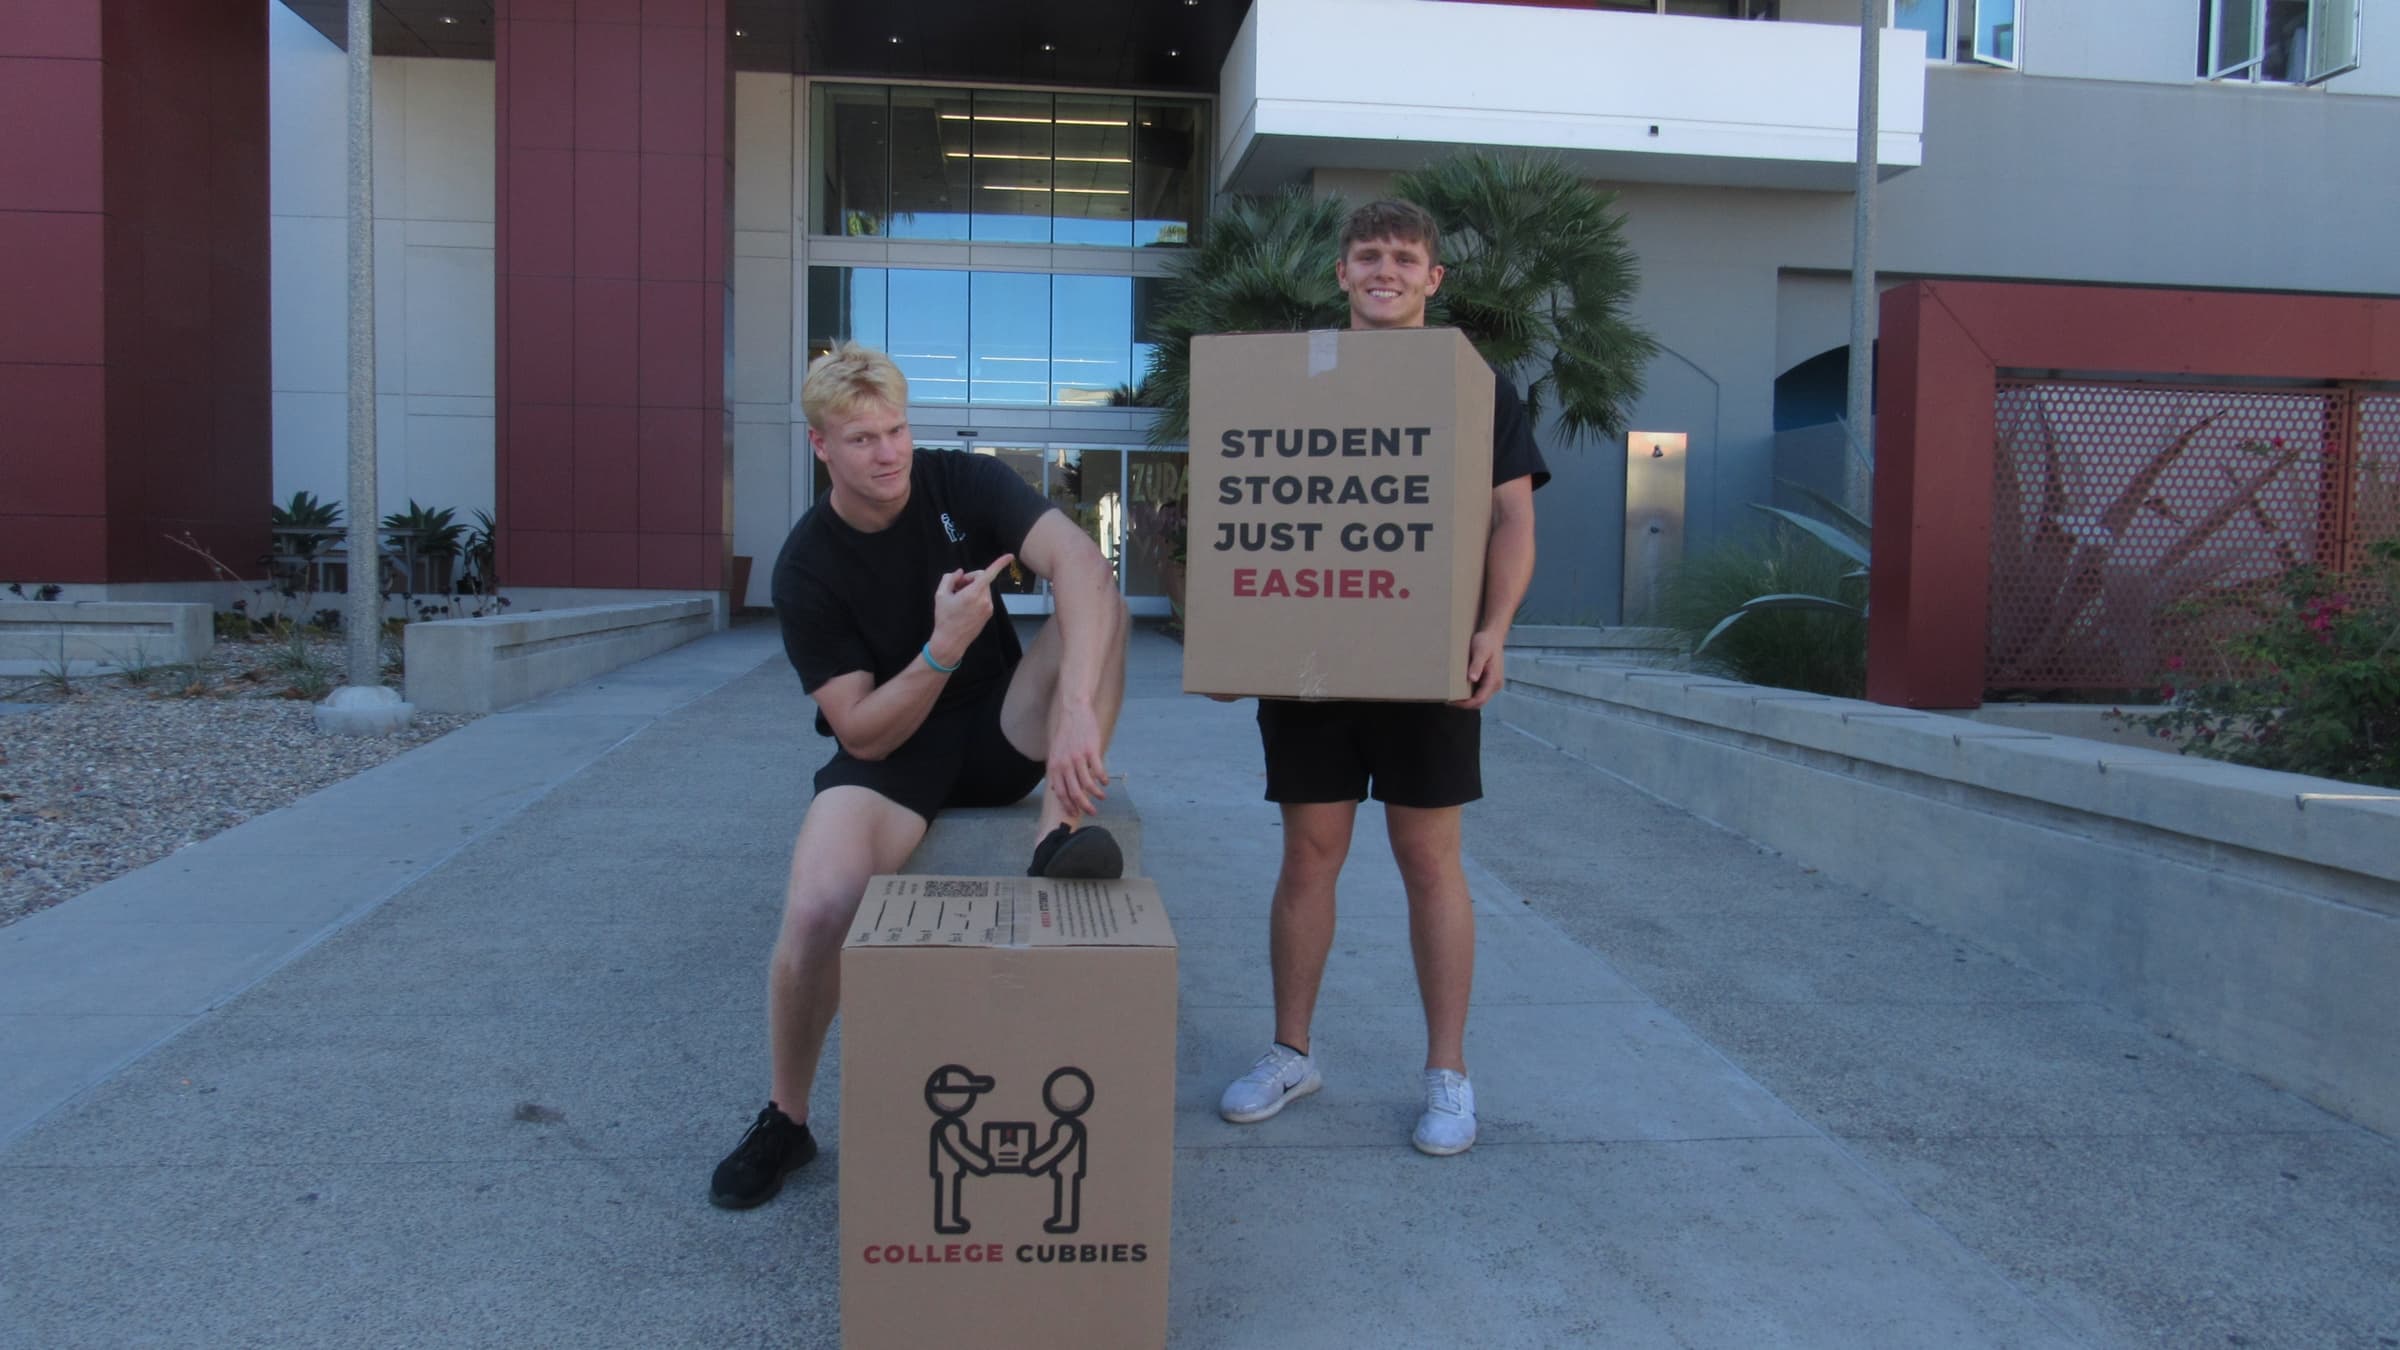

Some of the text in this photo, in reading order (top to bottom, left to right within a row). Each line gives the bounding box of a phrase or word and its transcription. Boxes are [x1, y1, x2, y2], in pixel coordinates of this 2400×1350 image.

[1221, 427, 1431, 458] STUDENT
[1218, 475, 1430, 505] STORAGE
[1213, 522, 1433, 553] JUST GOT
[1233, 568, 1411, 600] EASIER.
[863, 1243, 1148, 1265] COLLEGE CUBBIES
